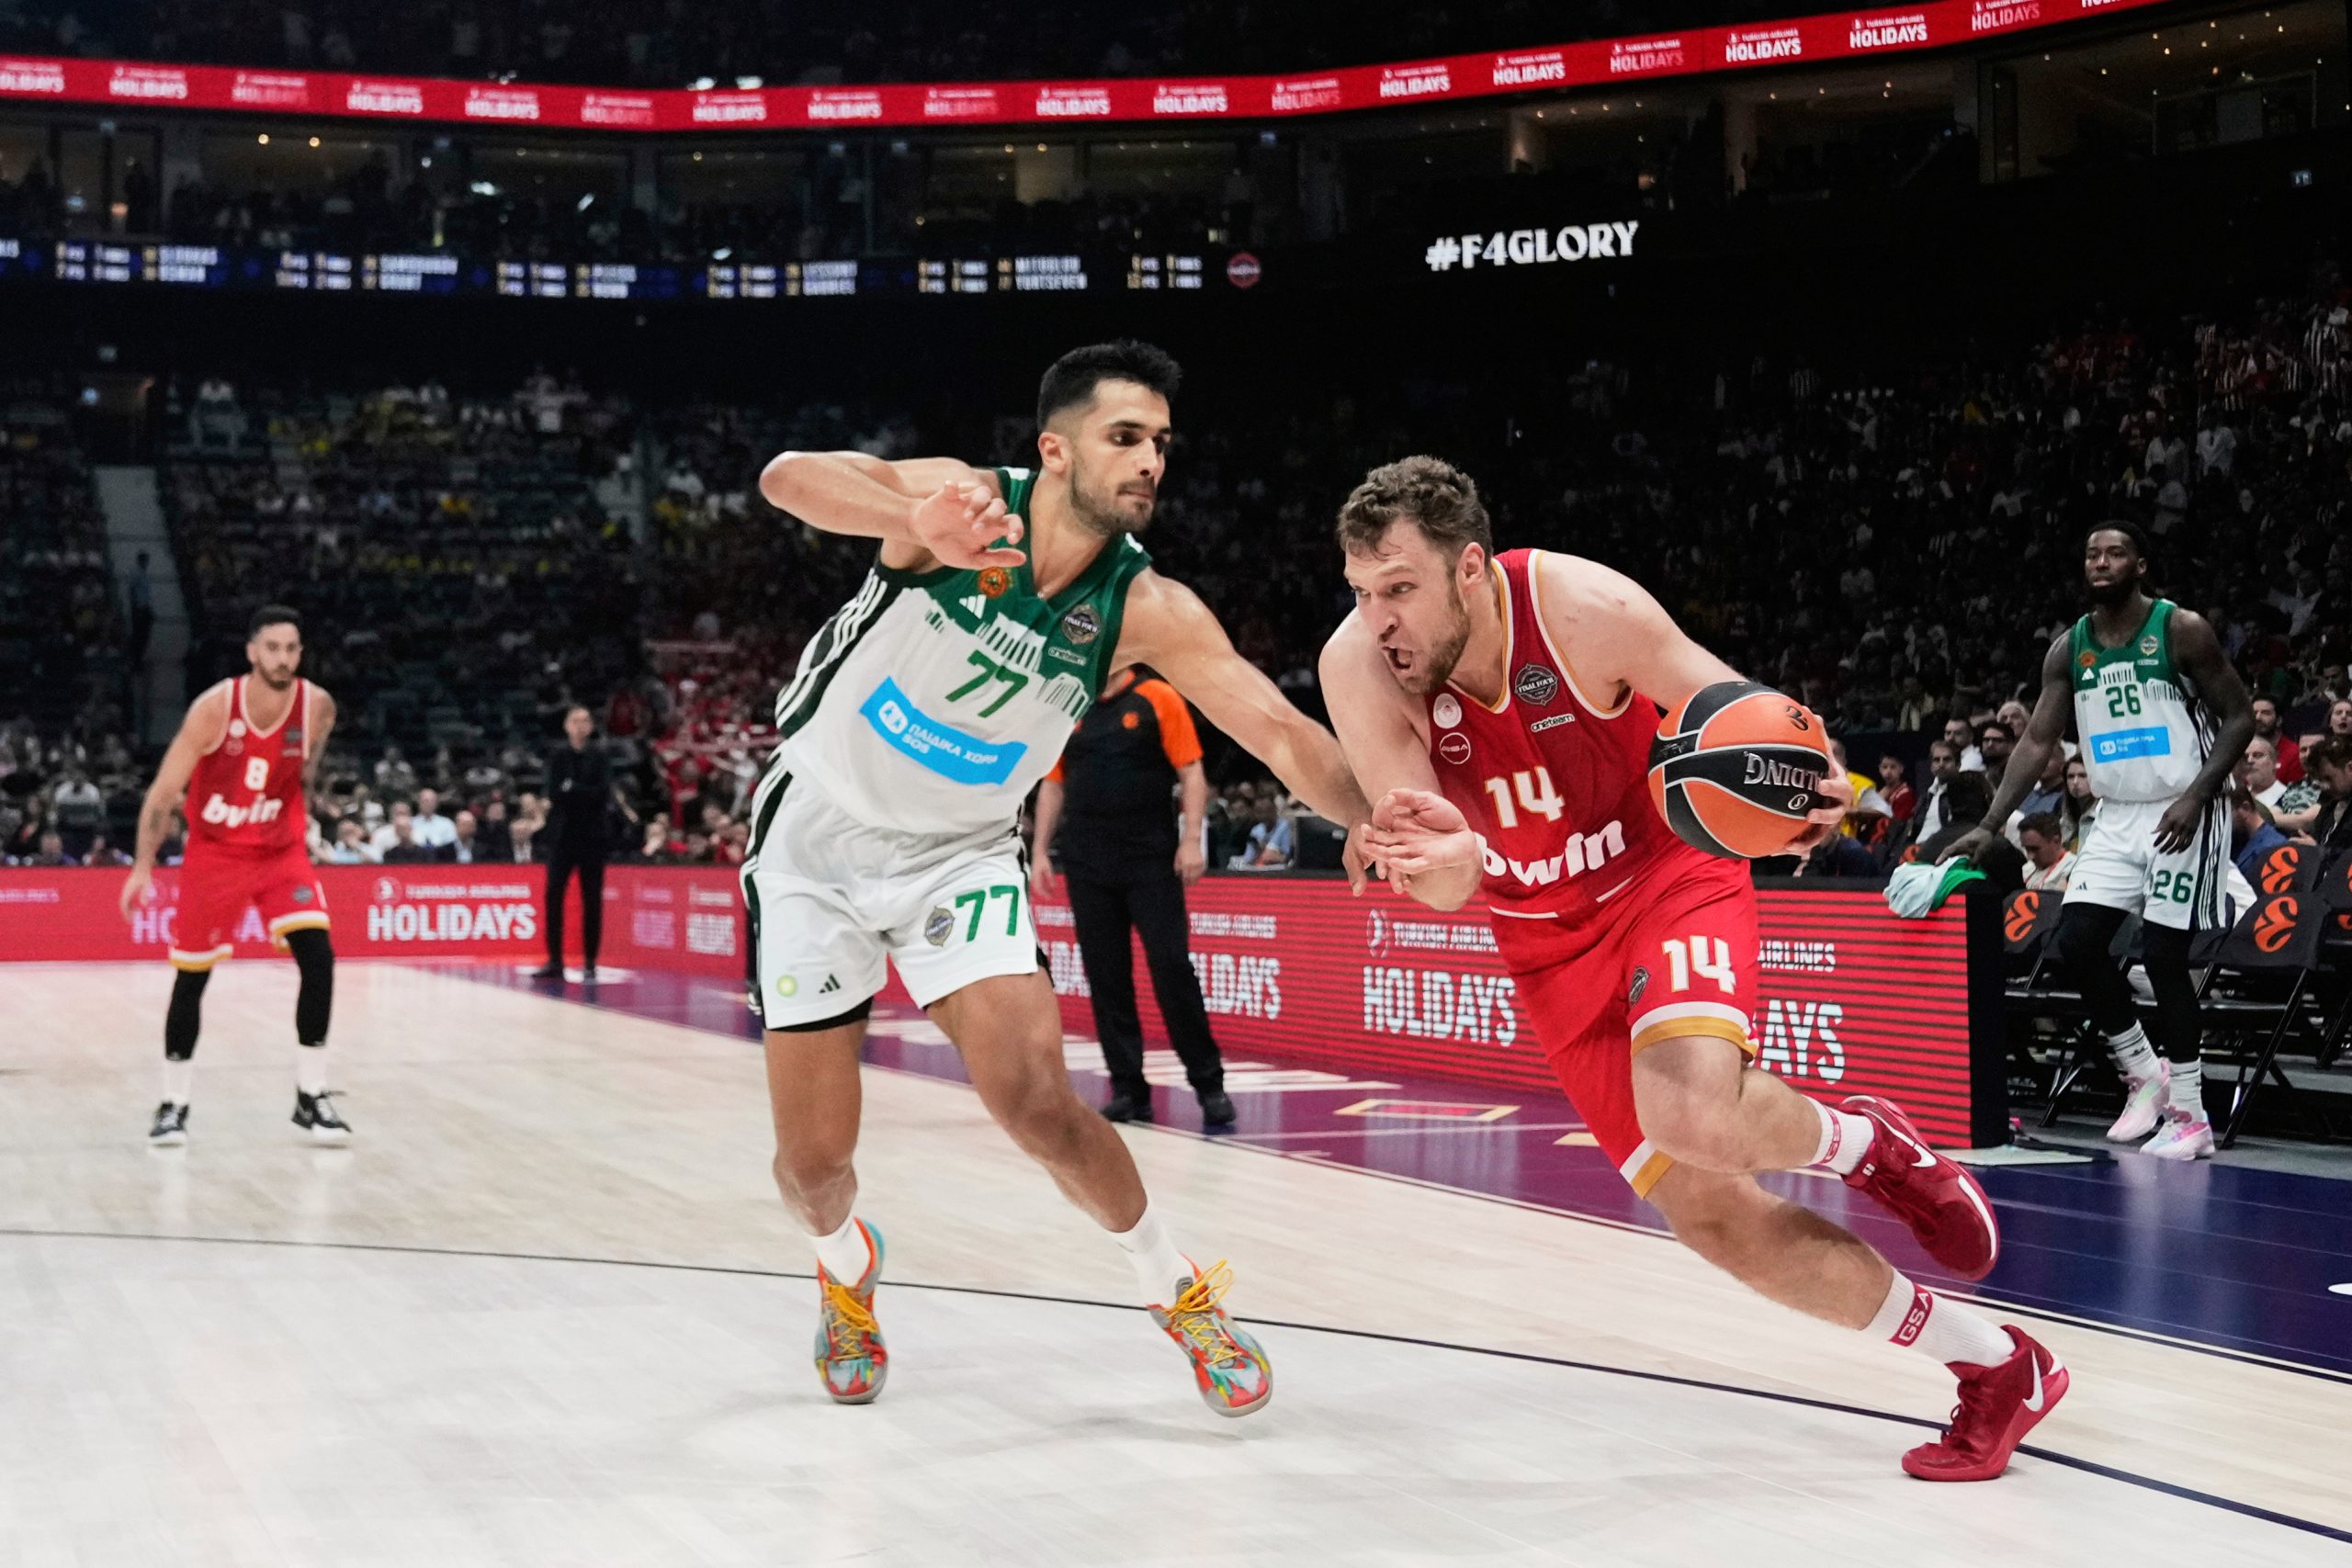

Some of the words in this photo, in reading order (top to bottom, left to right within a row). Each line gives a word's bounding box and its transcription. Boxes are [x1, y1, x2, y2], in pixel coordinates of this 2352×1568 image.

[1971, 3, 2041, 31] HOLIDAYS
[1725, 37, 1802, 62] HOLIDAYS
[1849, 22, 1928, 49] HOLIDAYS
[1493, 62, 1566, 85] HOLIDAYS
[1610, 49, 1685, 73] HOLIDAYS
[1272, 89, 1341, 110] HOLIDAYS
[1380, 74, 1451, 98] HOLIDAYS
[1036, 96, 1111, 116] HOLIDAYS
[1154, 95, 1228, 114] HOLIDAYS
[1425, 220, 1639, 272] #F4GLORY
[944, 649, 1029, 718] 77
[1518, 682, 1536, 694] FINAL
[2105, 684, 2142, 718] 26
[1531, 715, 1575, 731] oneteam
[244, 756, 269, 791] 8
[201, 792, 283, 829] bwin
[1485, 765, 1566, 829] 14
[1474, 819, 1626, 887] bwin
[2152, 869, 2194, 904] 26
[368, 903, 537, 942] HOLIDAYS
[956, 885, 1019, 942] 77
[1392, 921, 1448, 949] TURKISH
[1449, 925, 1499, 953] AIRLIN
[1661, 934, 1736, 995] 14
[1757, 939, 1837, 974] AIRLINES
[1188, 952, 1282, 1021] LIDAYS
[1363, 965, 1518, 1047] HOLIDAYS
[1898, 1292, 1929, 1342] GSA
